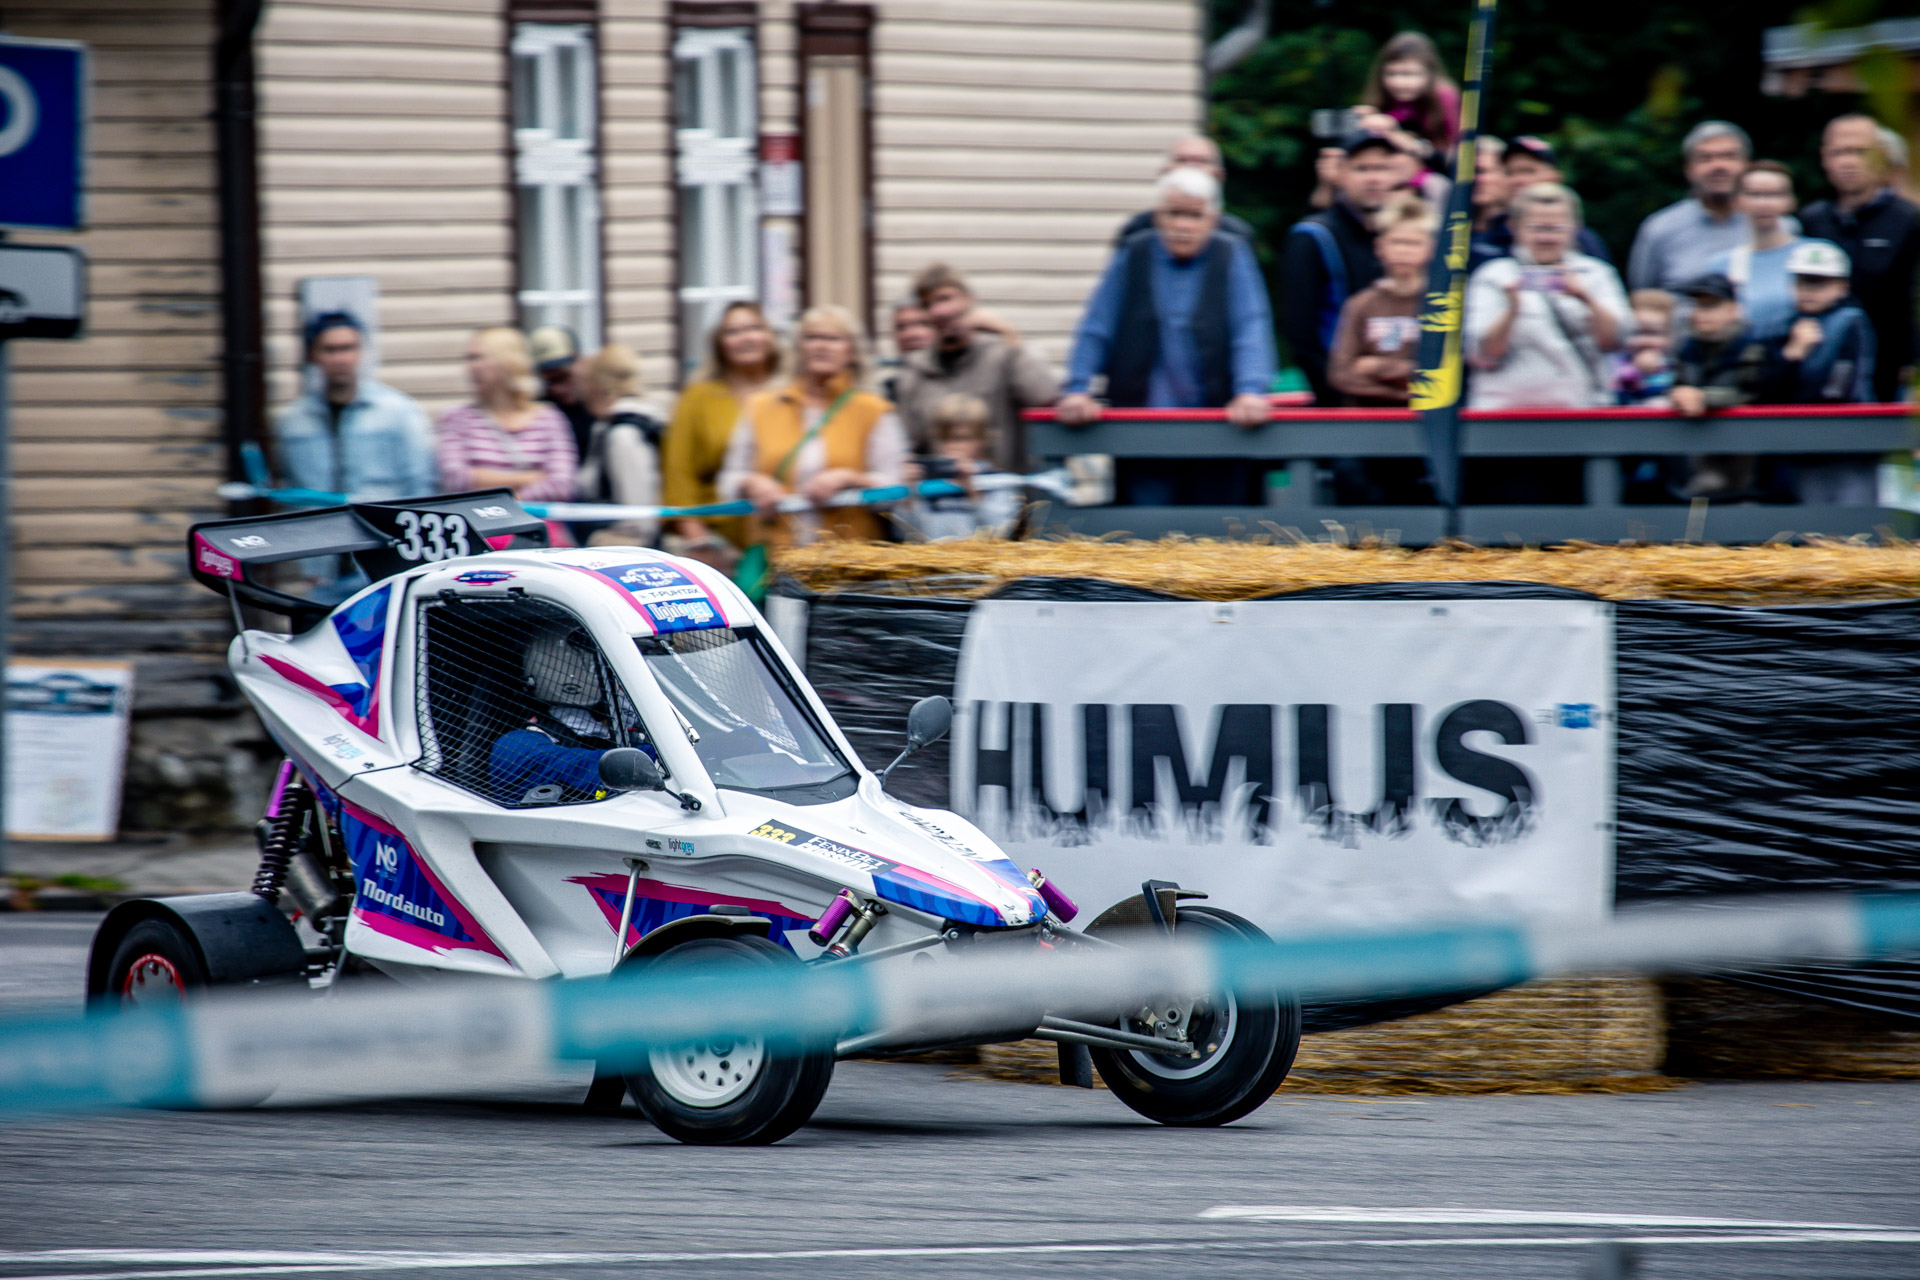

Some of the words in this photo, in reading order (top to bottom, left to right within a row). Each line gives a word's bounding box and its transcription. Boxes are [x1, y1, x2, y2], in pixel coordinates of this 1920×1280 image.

[395, 511, 471, 560] 333
[619, 573, 648, 584] SKY
[647, 601, 714, 622] lightgrey
[971, 699, 1548, 848] HUMUS
[749, 824, 797, 843] 333
[667, 837, 695, 854] lightgrey
[363, 878, 445, 927] Nordauto
